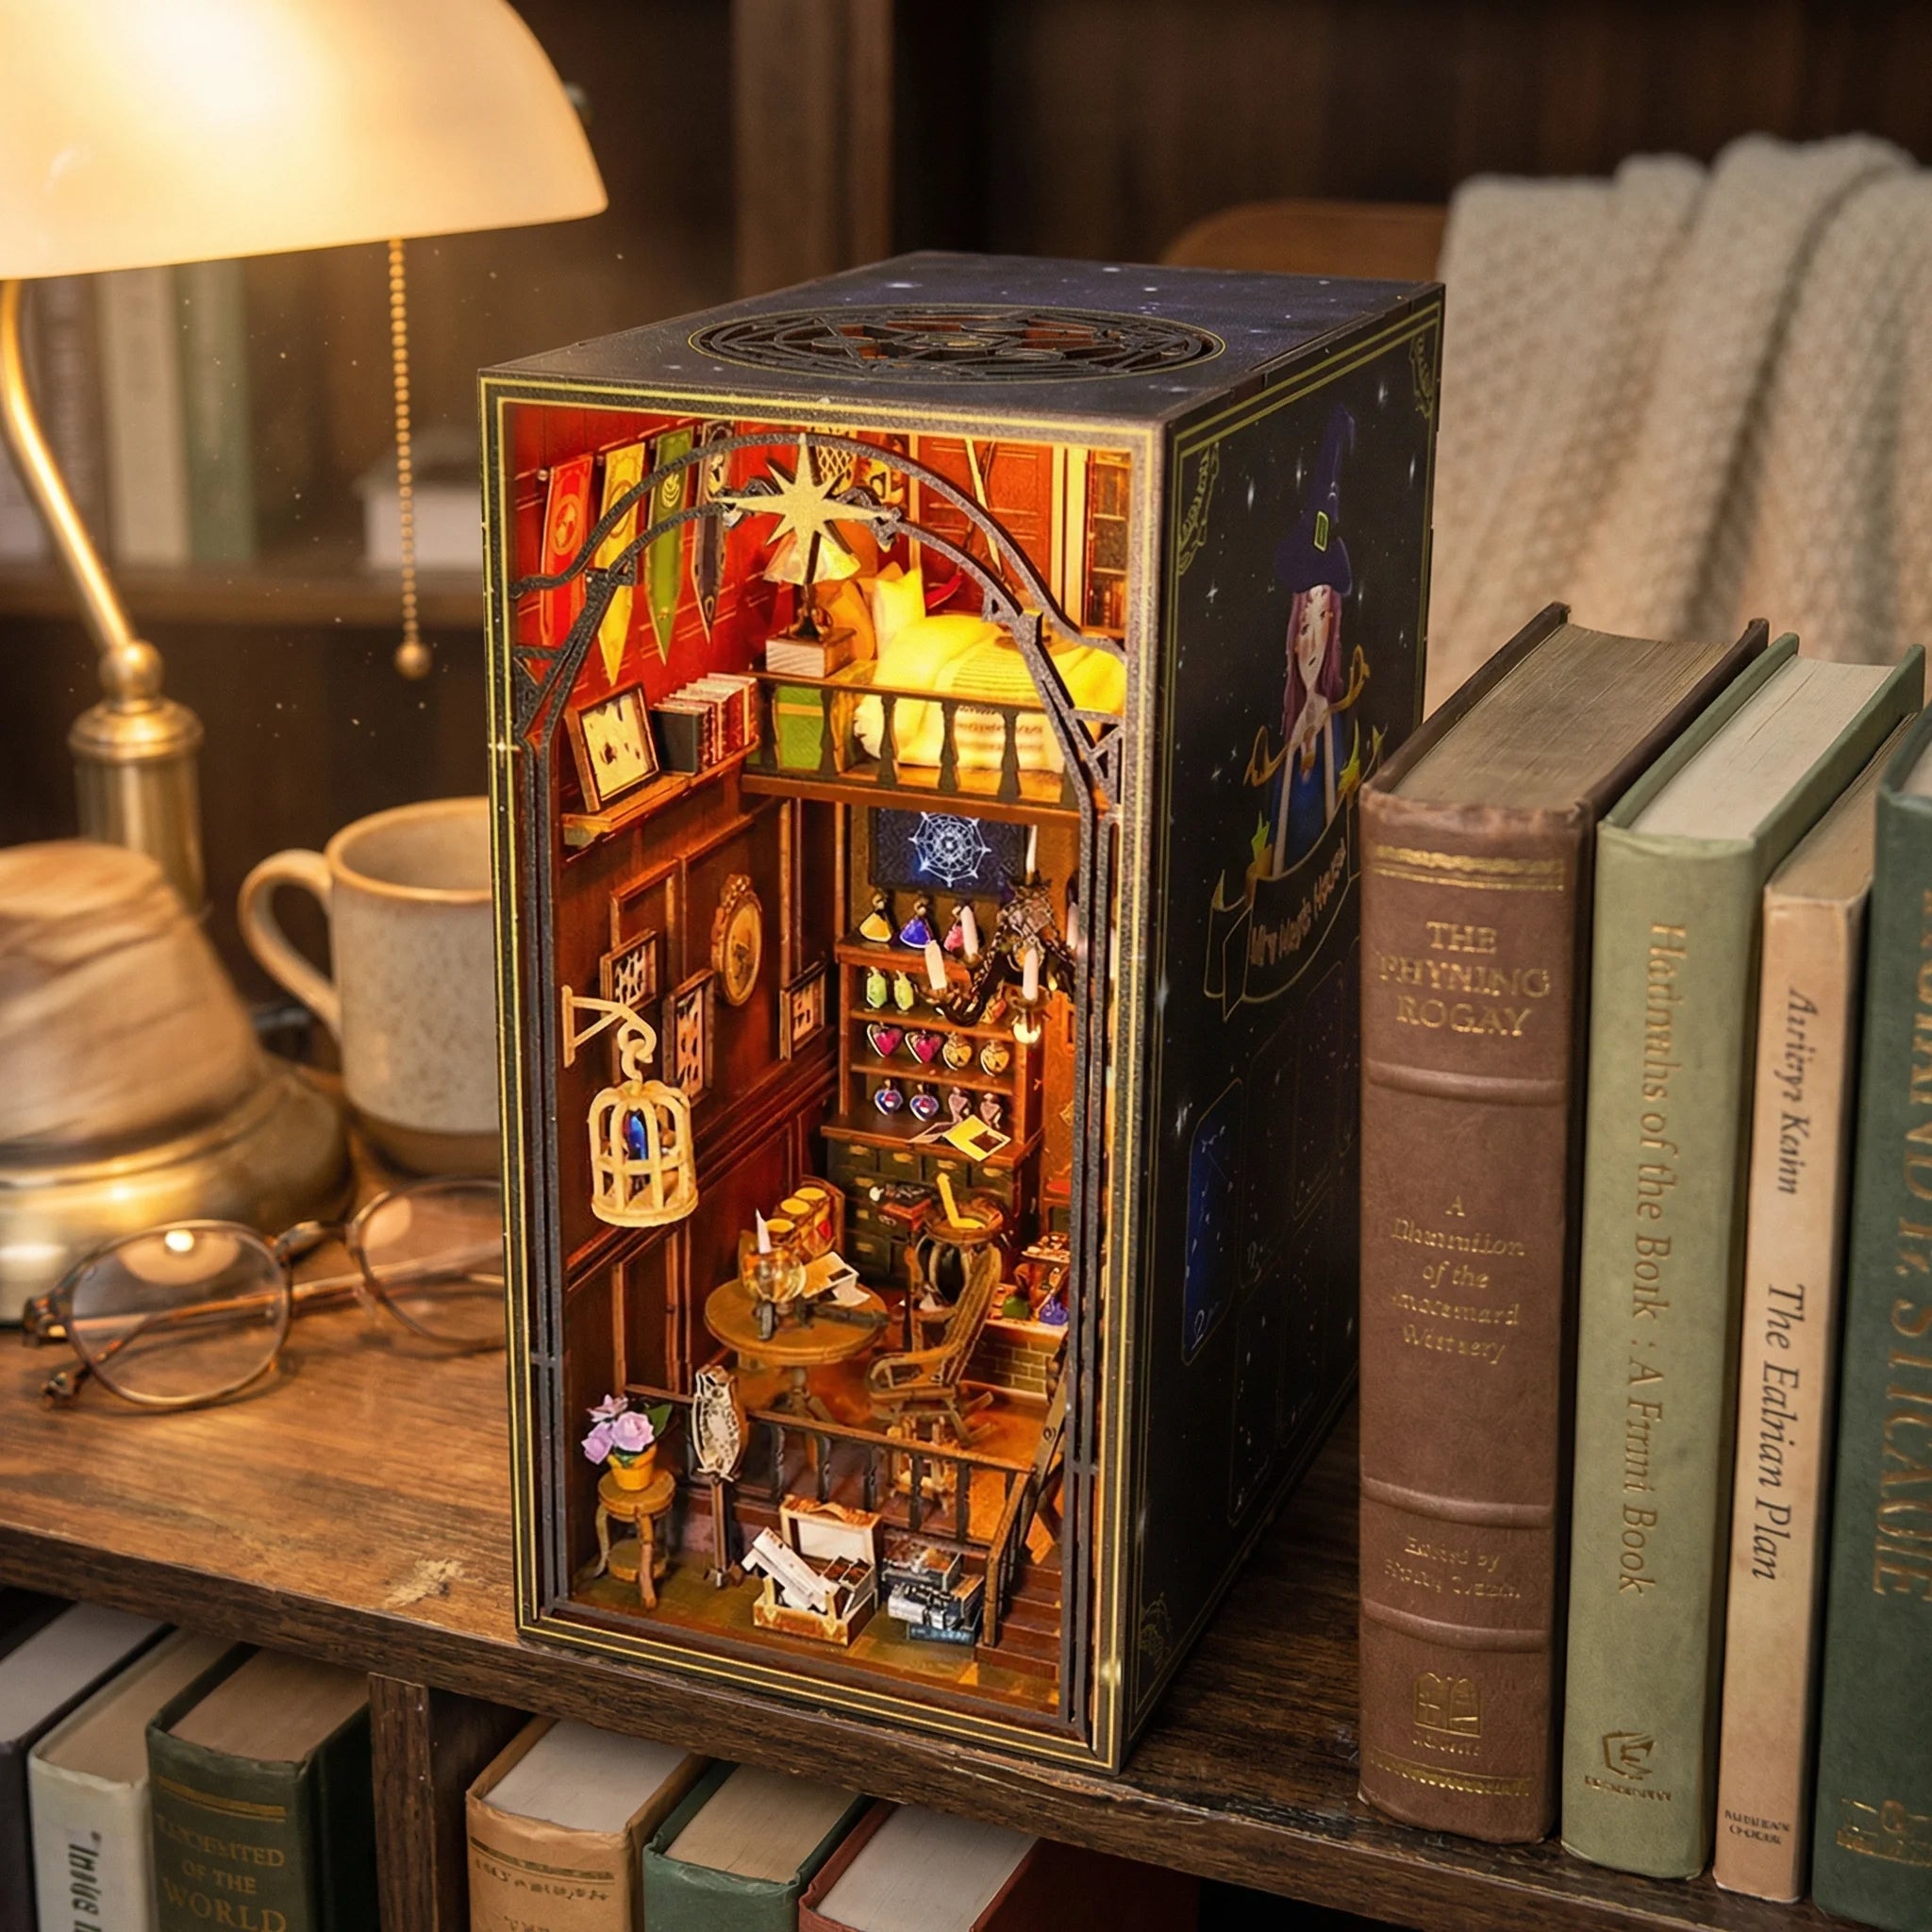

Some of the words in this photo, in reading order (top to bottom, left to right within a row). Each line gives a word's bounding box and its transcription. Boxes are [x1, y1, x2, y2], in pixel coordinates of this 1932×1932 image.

[1425, 921, 1497, 955] THE
[1641, 1113, 1679, 1158] of
[1444, 1195, 1466, 1217] A
[1637, 1163, 1677, 1221] the
[1422, 1260, 1451, 1290] of
[1451, 1264, 1490, 1290] the
[1765, 1283, 1806, 1350] The
[1628, 1357, 1665, 1386] A
[1619, 1504, 1657, 1597] Book
[1752, 1496, 1792, 1580] Plan
[211, 1868, 258, 1894] THE
[162, 1876, 288, 1932] WORLD
